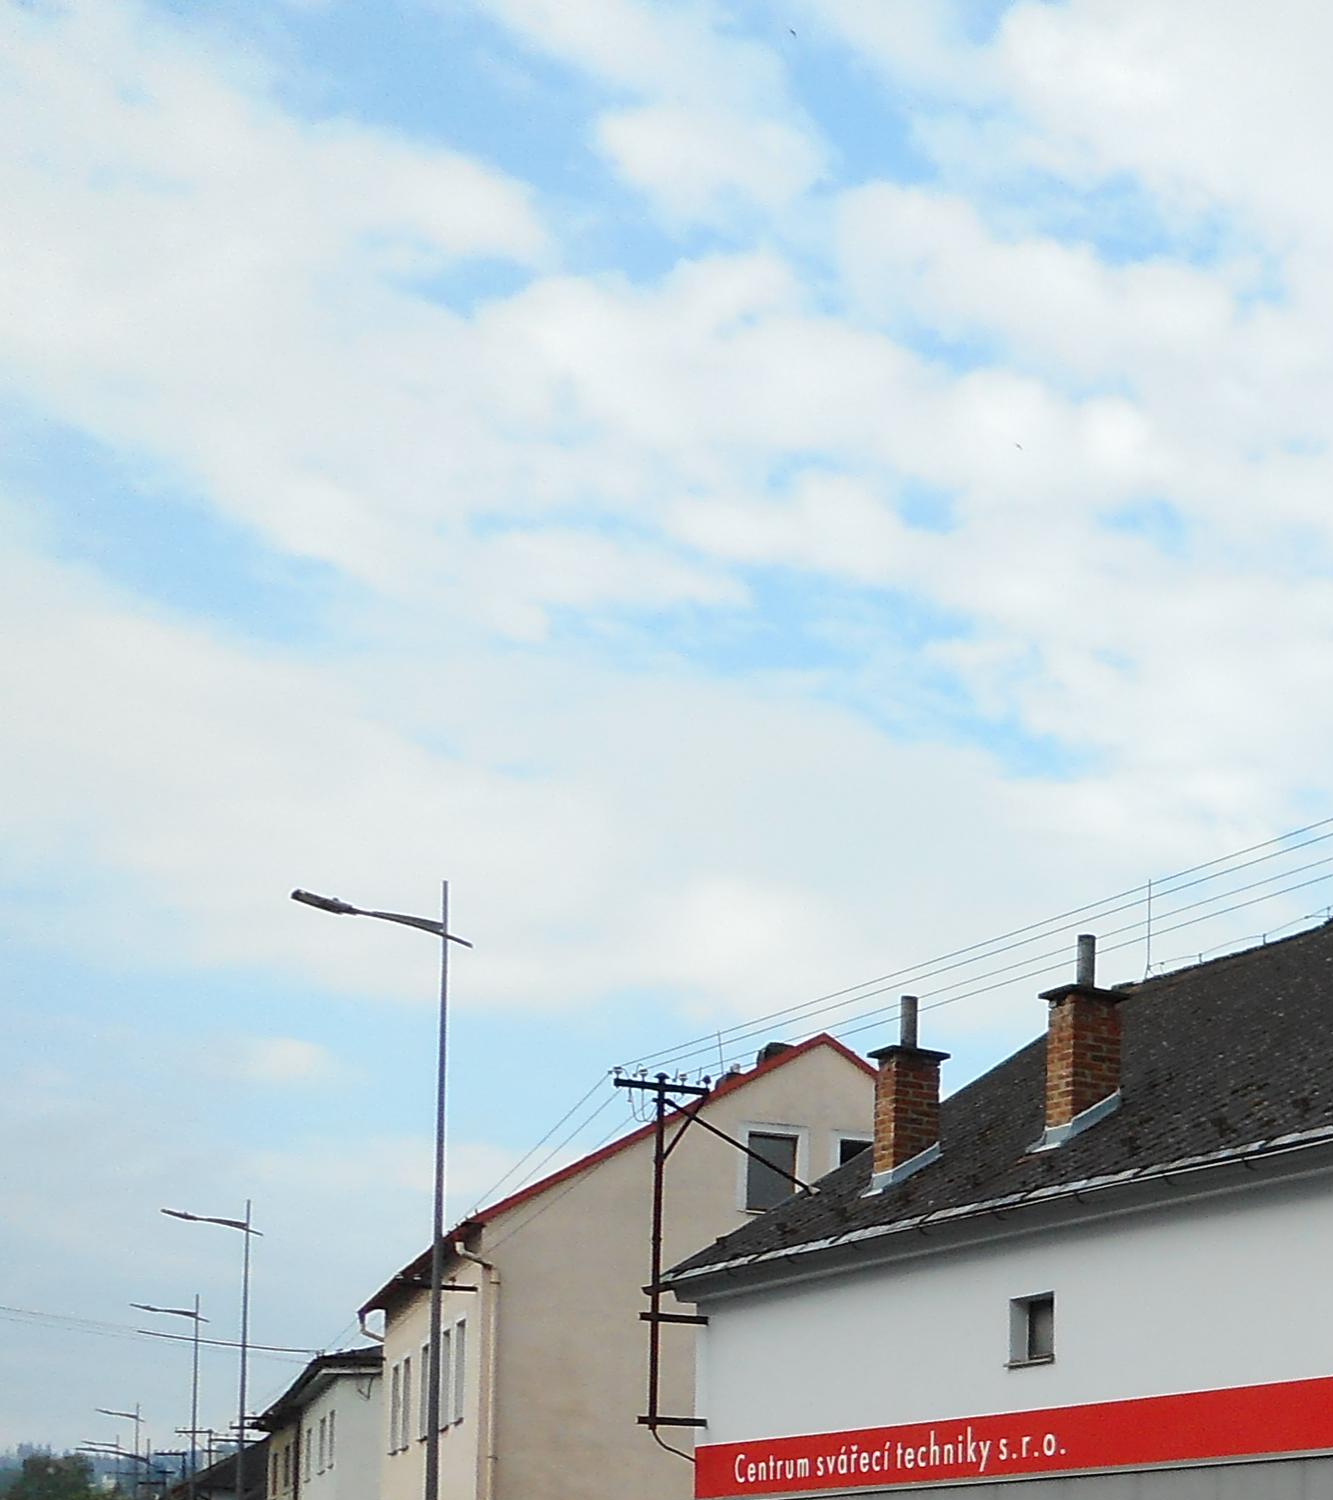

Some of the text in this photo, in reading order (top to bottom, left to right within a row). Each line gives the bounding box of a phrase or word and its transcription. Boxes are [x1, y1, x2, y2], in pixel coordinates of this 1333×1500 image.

[733, 1426, 1068, 1484] Centrum svářecí techniky s.r.o.
